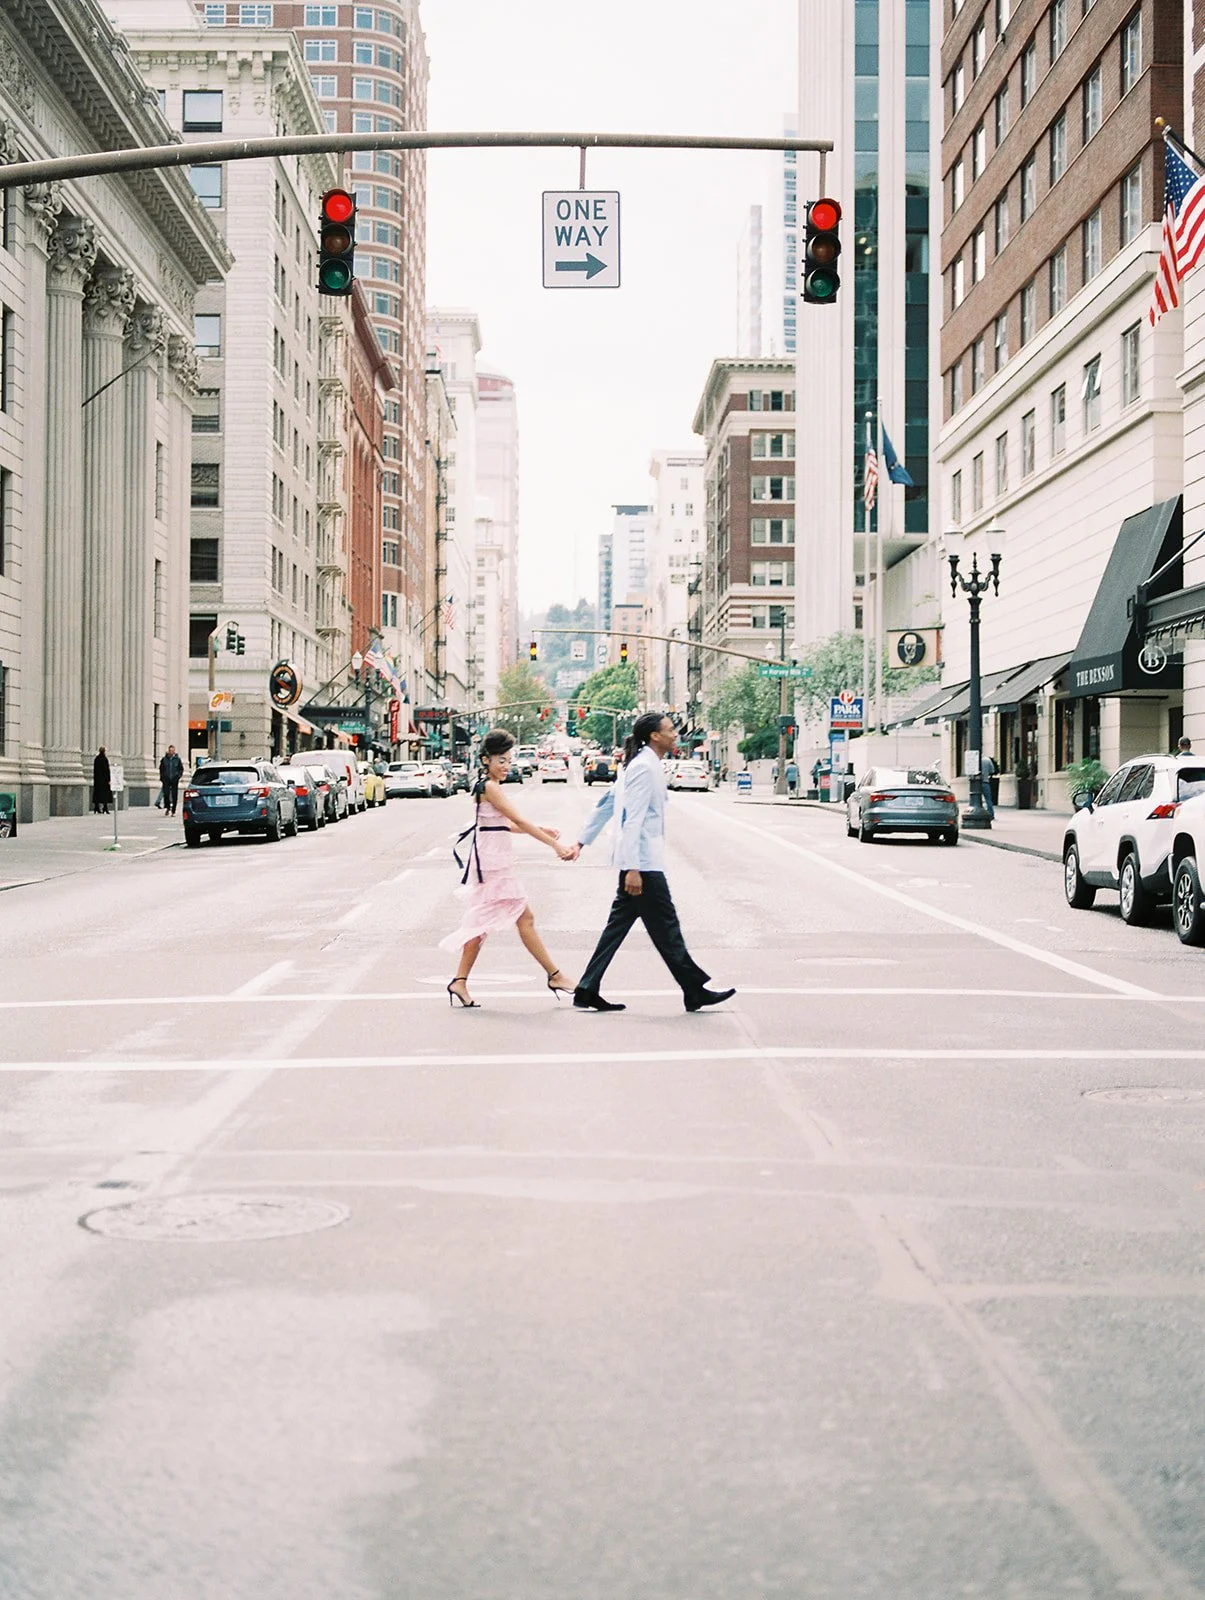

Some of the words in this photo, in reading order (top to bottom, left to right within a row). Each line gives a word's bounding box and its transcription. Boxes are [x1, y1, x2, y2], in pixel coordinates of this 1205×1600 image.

[556, 199, 607, 220] ONE
[555, 226, 609, 247] WAY
[1146, 652, 1160, 668] B
[1076, 670, 1089, 688] THE
[1089, 664, 1115, 685] BENSON
[833, 704, 861, 715] PARK
